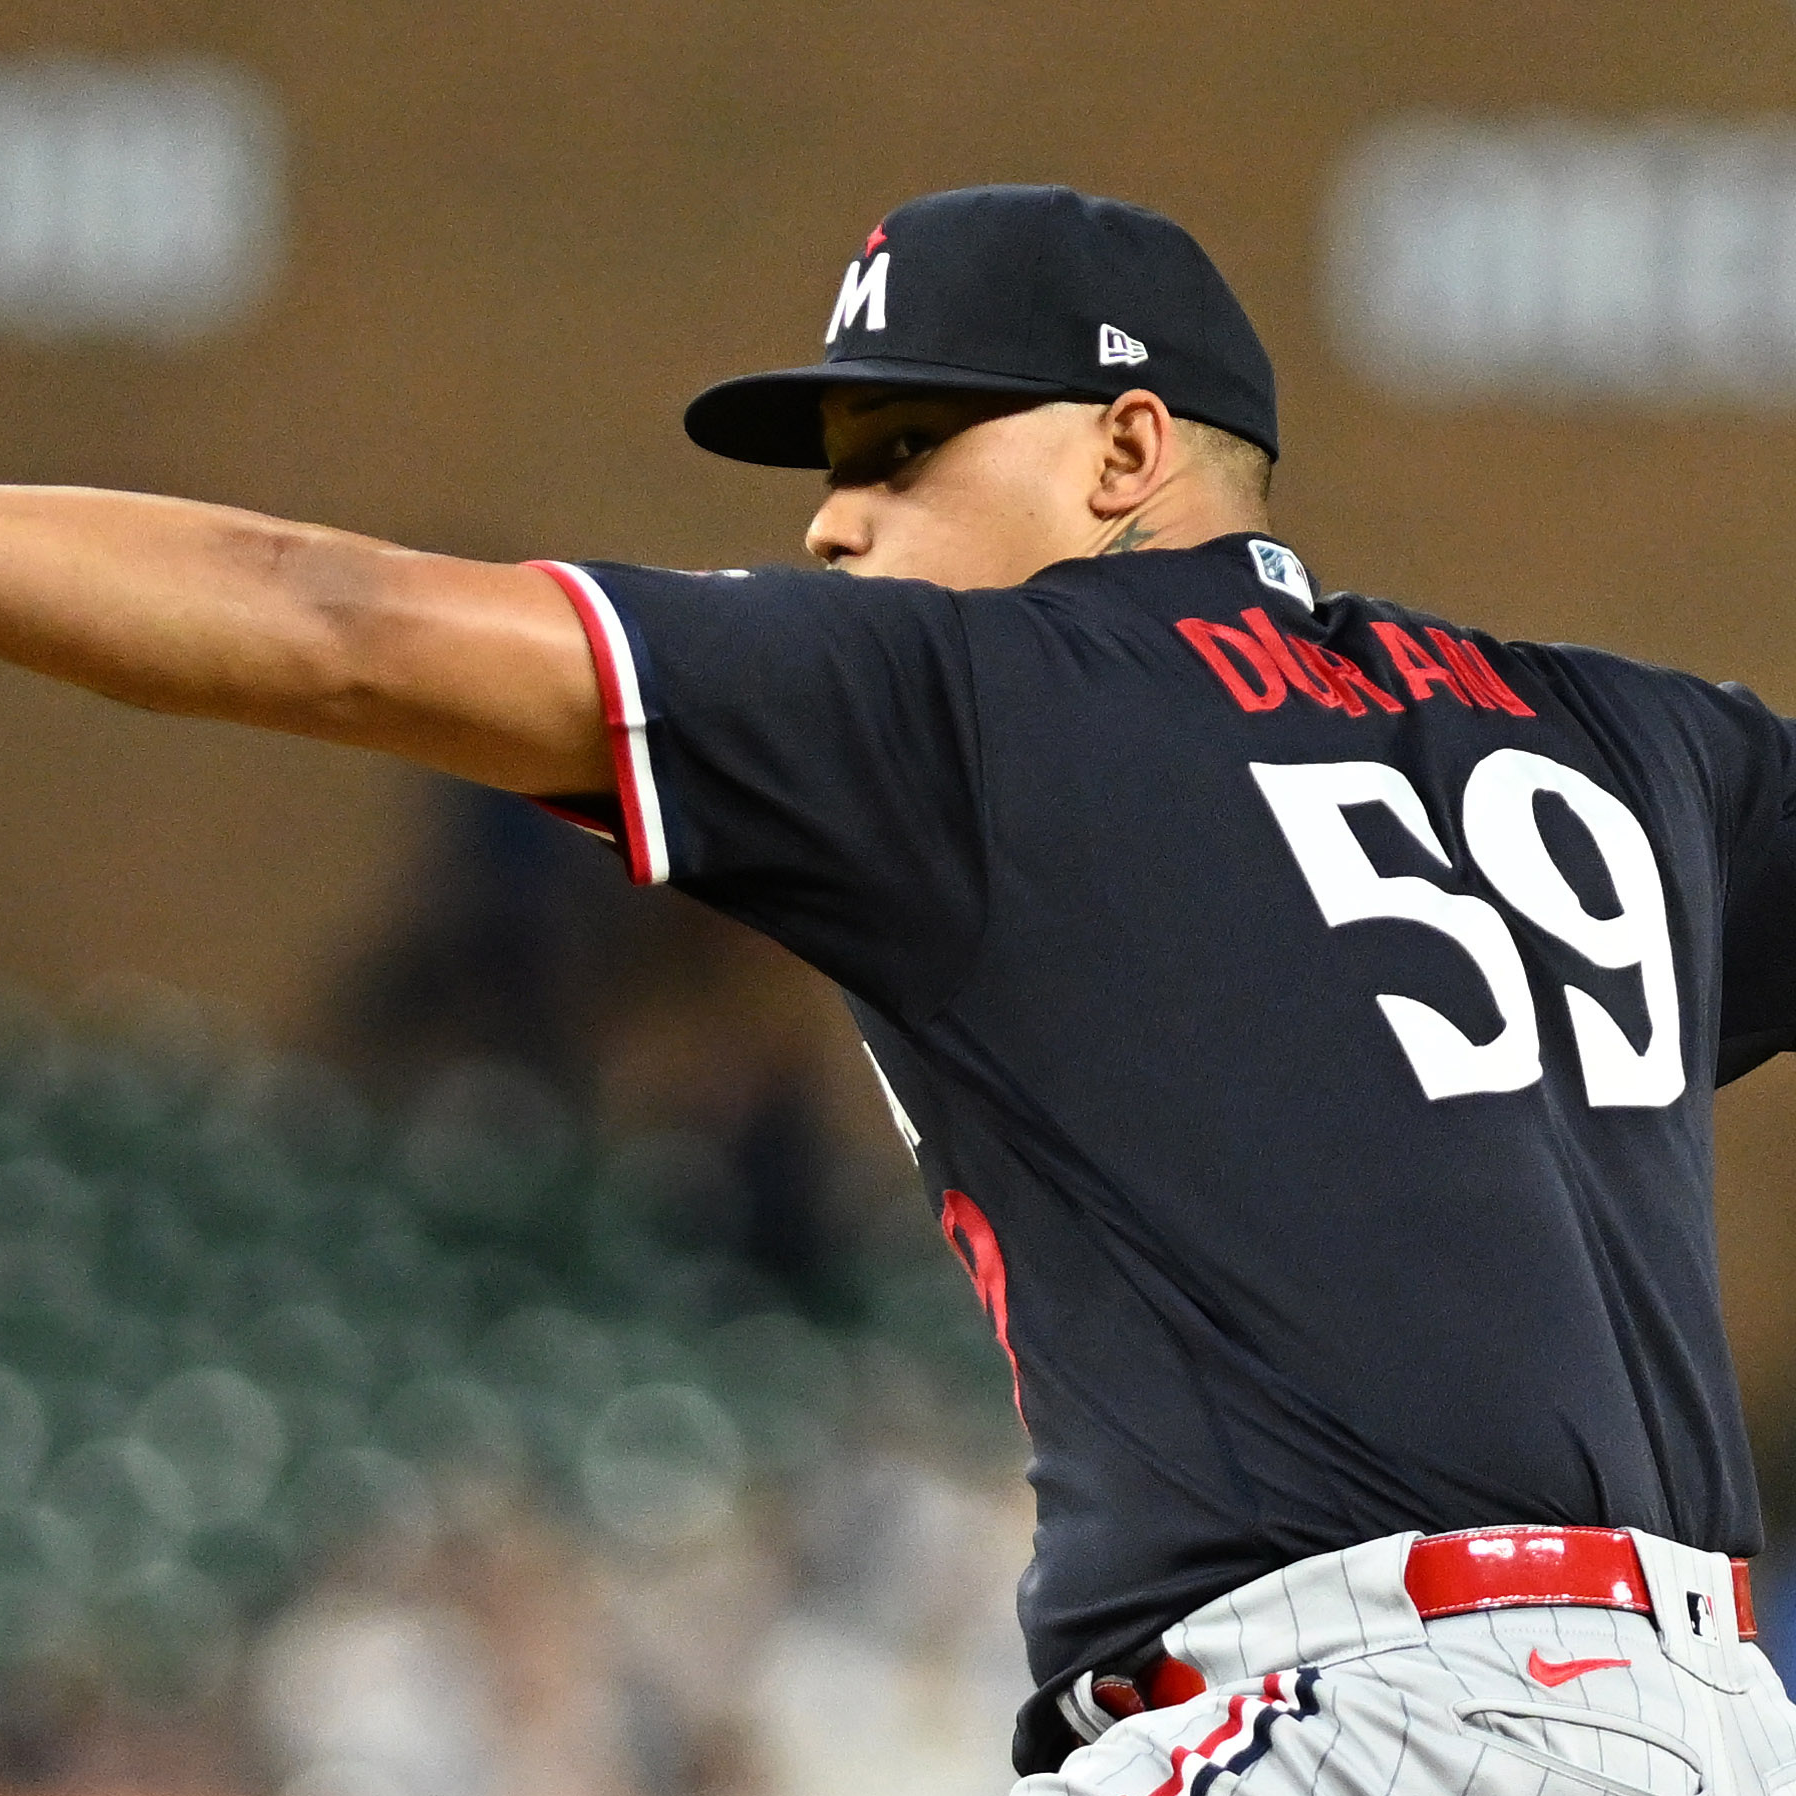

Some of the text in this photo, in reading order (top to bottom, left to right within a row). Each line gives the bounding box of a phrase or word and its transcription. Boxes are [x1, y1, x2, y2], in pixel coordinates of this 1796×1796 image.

[825, 252, 890, 345] M
[1173, 606, 1537, 719] DURAN
[1249, 747, 1686, 1107] 59
